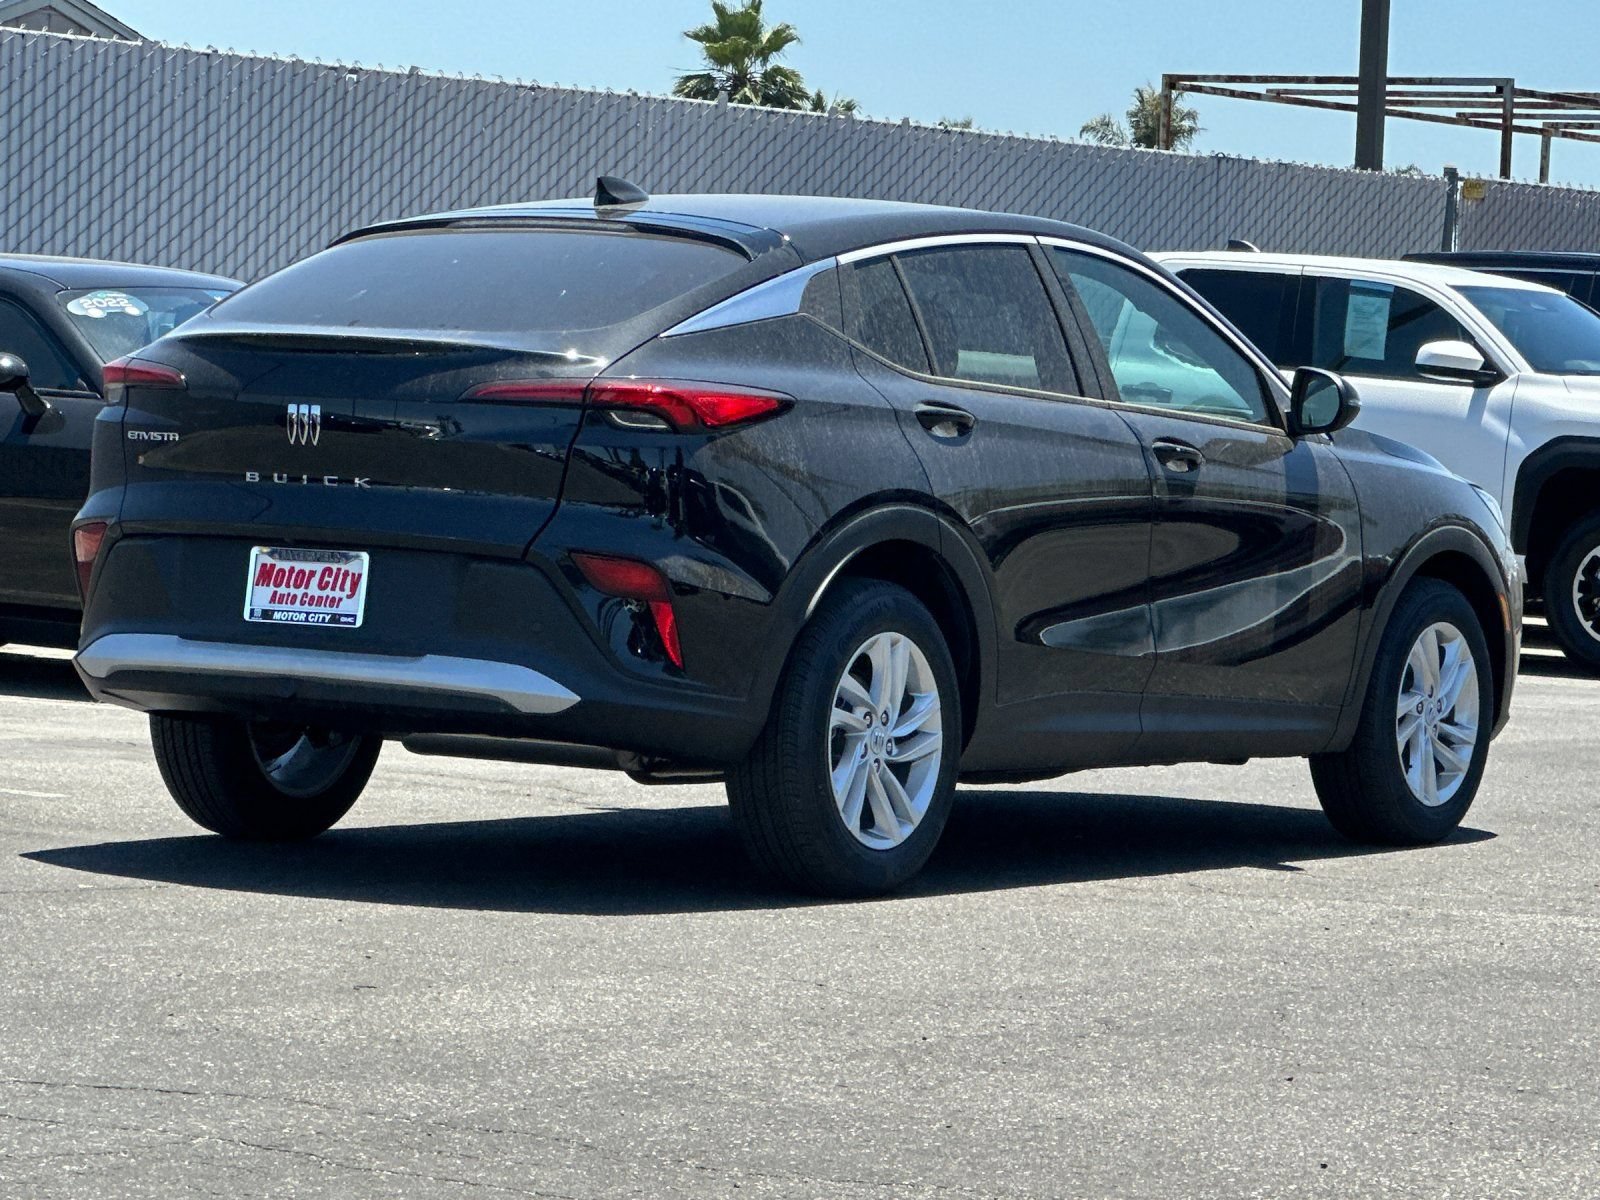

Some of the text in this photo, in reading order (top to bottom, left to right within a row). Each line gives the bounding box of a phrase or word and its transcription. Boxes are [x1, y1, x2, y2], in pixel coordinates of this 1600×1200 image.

[127, 430, 179, 442] ENVISTA
[245, 471, 372, 489] BUICK
[255, 563, 362, 599] Motor City
[269, 590, 343, 609] Auto Center
[272, 611, 332, 623] MOTOR CITY
